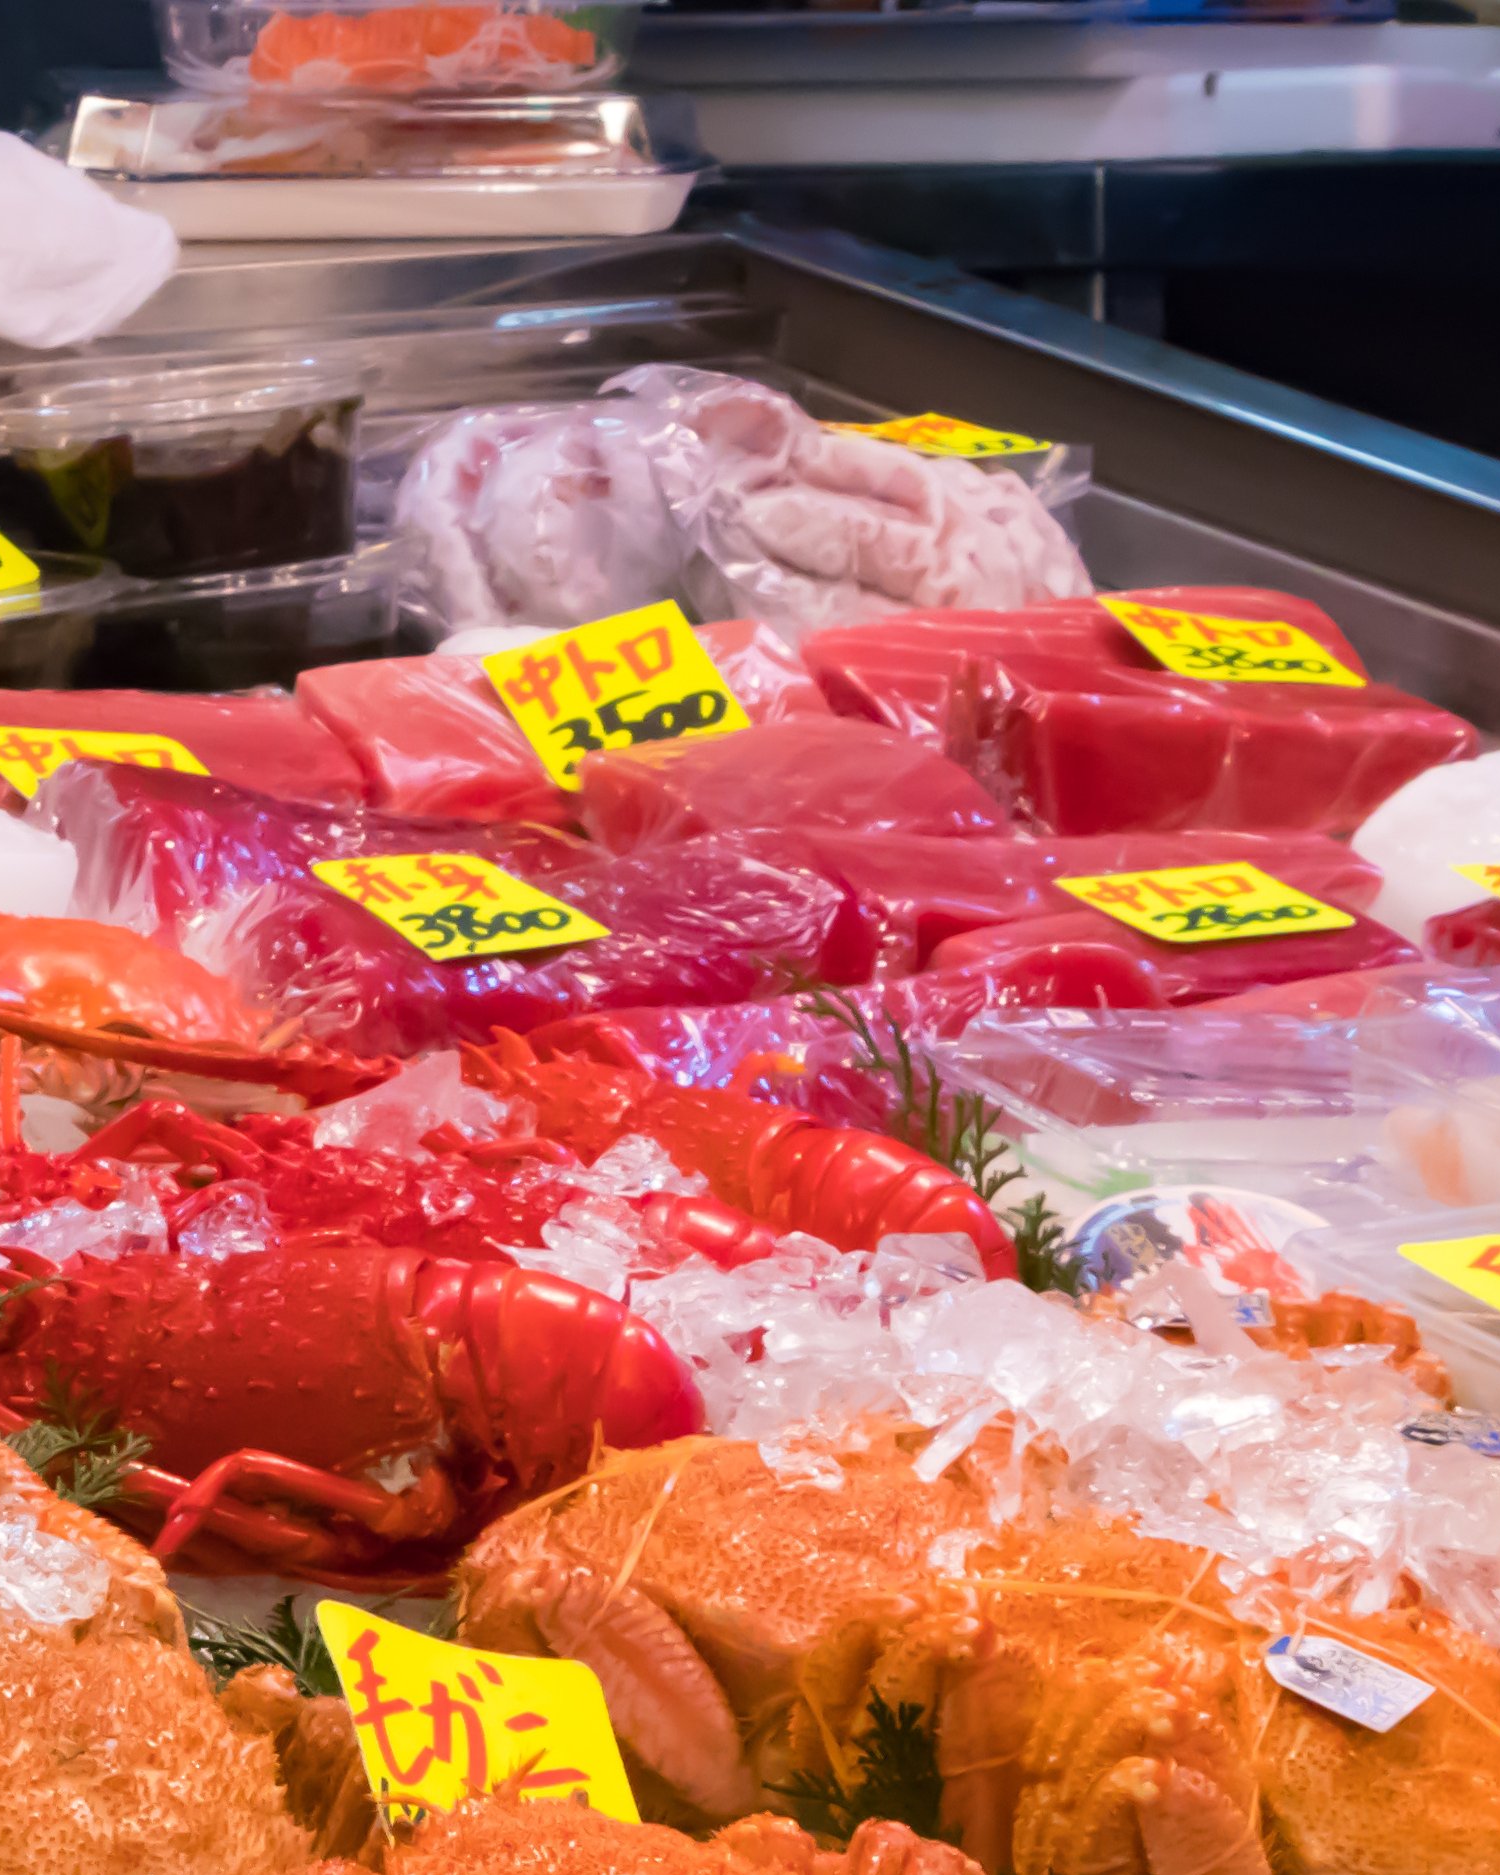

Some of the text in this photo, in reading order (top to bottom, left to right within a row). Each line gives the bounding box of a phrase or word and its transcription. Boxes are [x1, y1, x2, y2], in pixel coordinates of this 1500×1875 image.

[1124, 606, 1293, 648] 中トロ
[502, 625, 675, 721] 中トロ
[343, 857, 500, 904] 赤身
[1084, 874, 1256, 913] 中トロ
[346, 1628, 591, 1790] 毛ガニ
